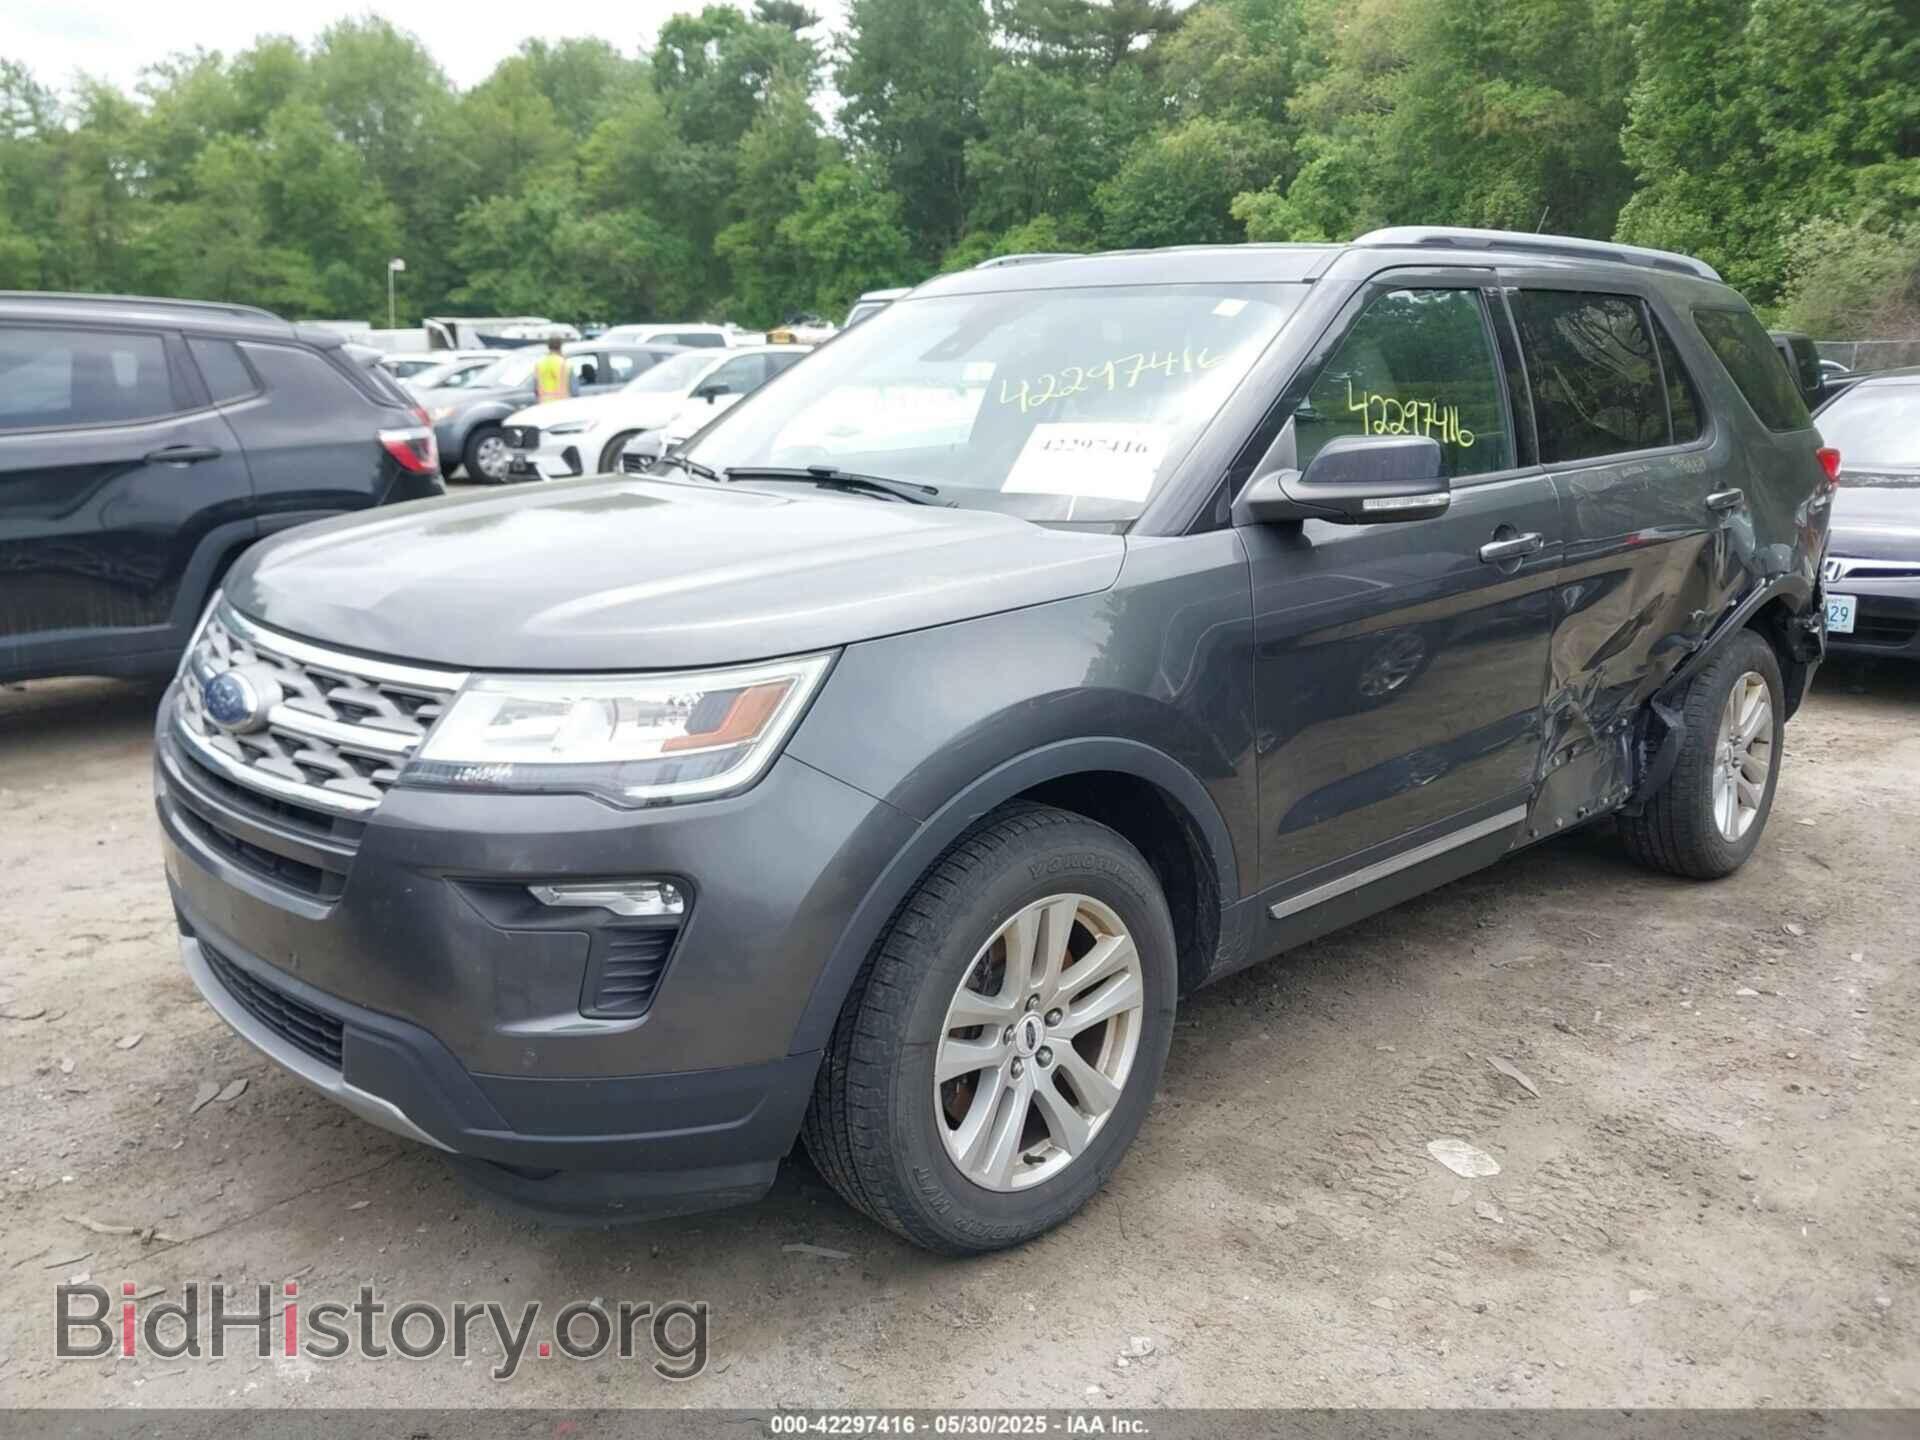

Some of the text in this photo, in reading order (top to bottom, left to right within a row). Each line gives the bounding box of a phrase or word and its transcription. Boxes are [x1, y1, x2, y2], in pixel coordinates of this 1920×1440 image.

[999, 346, 1222, 414] 42297416
[1347, 379, 1475, 448] 42297416
[1825, 606, 1849, 622] 29
